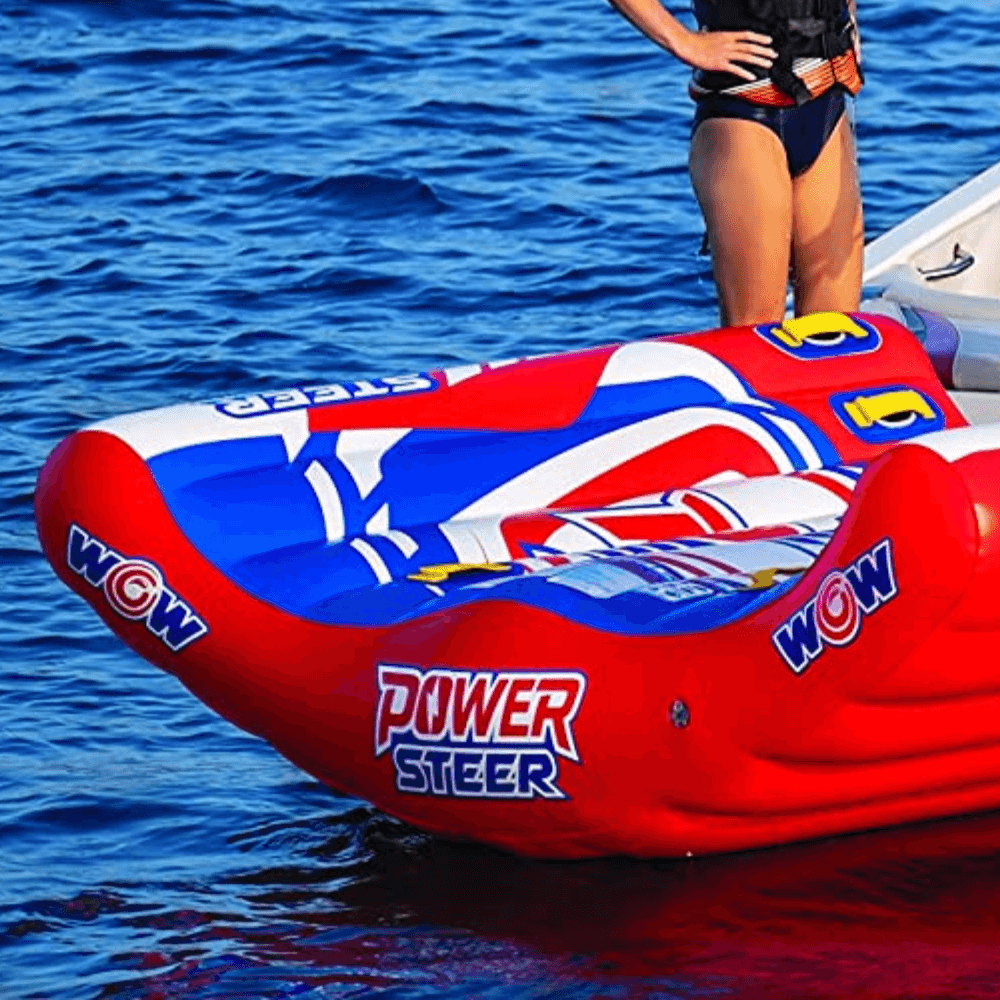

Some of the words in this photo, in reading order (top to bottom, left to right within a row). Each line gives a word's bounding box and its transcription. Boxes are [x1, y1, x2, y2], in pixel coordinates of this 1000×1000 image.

[67, 523, 208, 652] WOW
[772, 538, 898, 674] WOW
[375, 664, 586, 762] POWER
[393, 743, 568, 799] STEER
